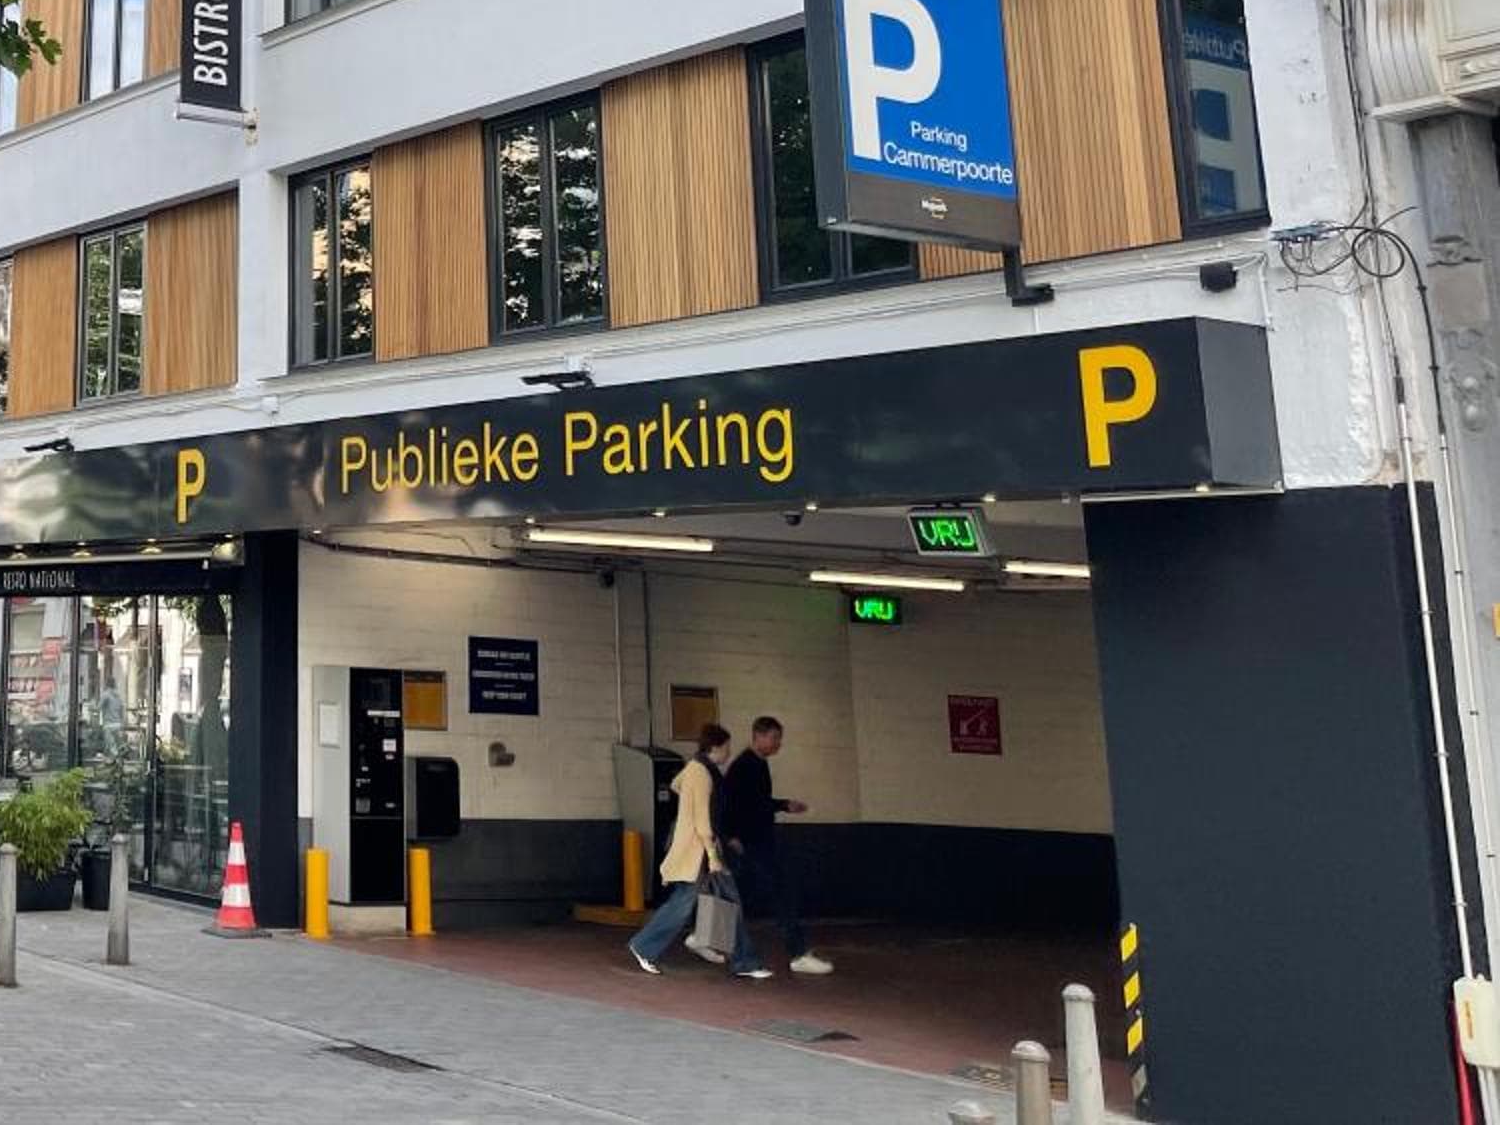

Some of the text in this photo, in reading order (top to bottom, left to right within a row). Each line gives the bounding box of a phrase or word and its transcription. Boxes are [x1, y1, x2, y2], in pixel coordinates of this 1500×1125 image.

[883, 141, 1013, 184] Cammerpoorte
[910, 120, 968, 152] Parking
[1078, 345, 1157, 468] P
[340, 399, 794, 493] Publieke Parking
[178, 448, 205, 524] P
